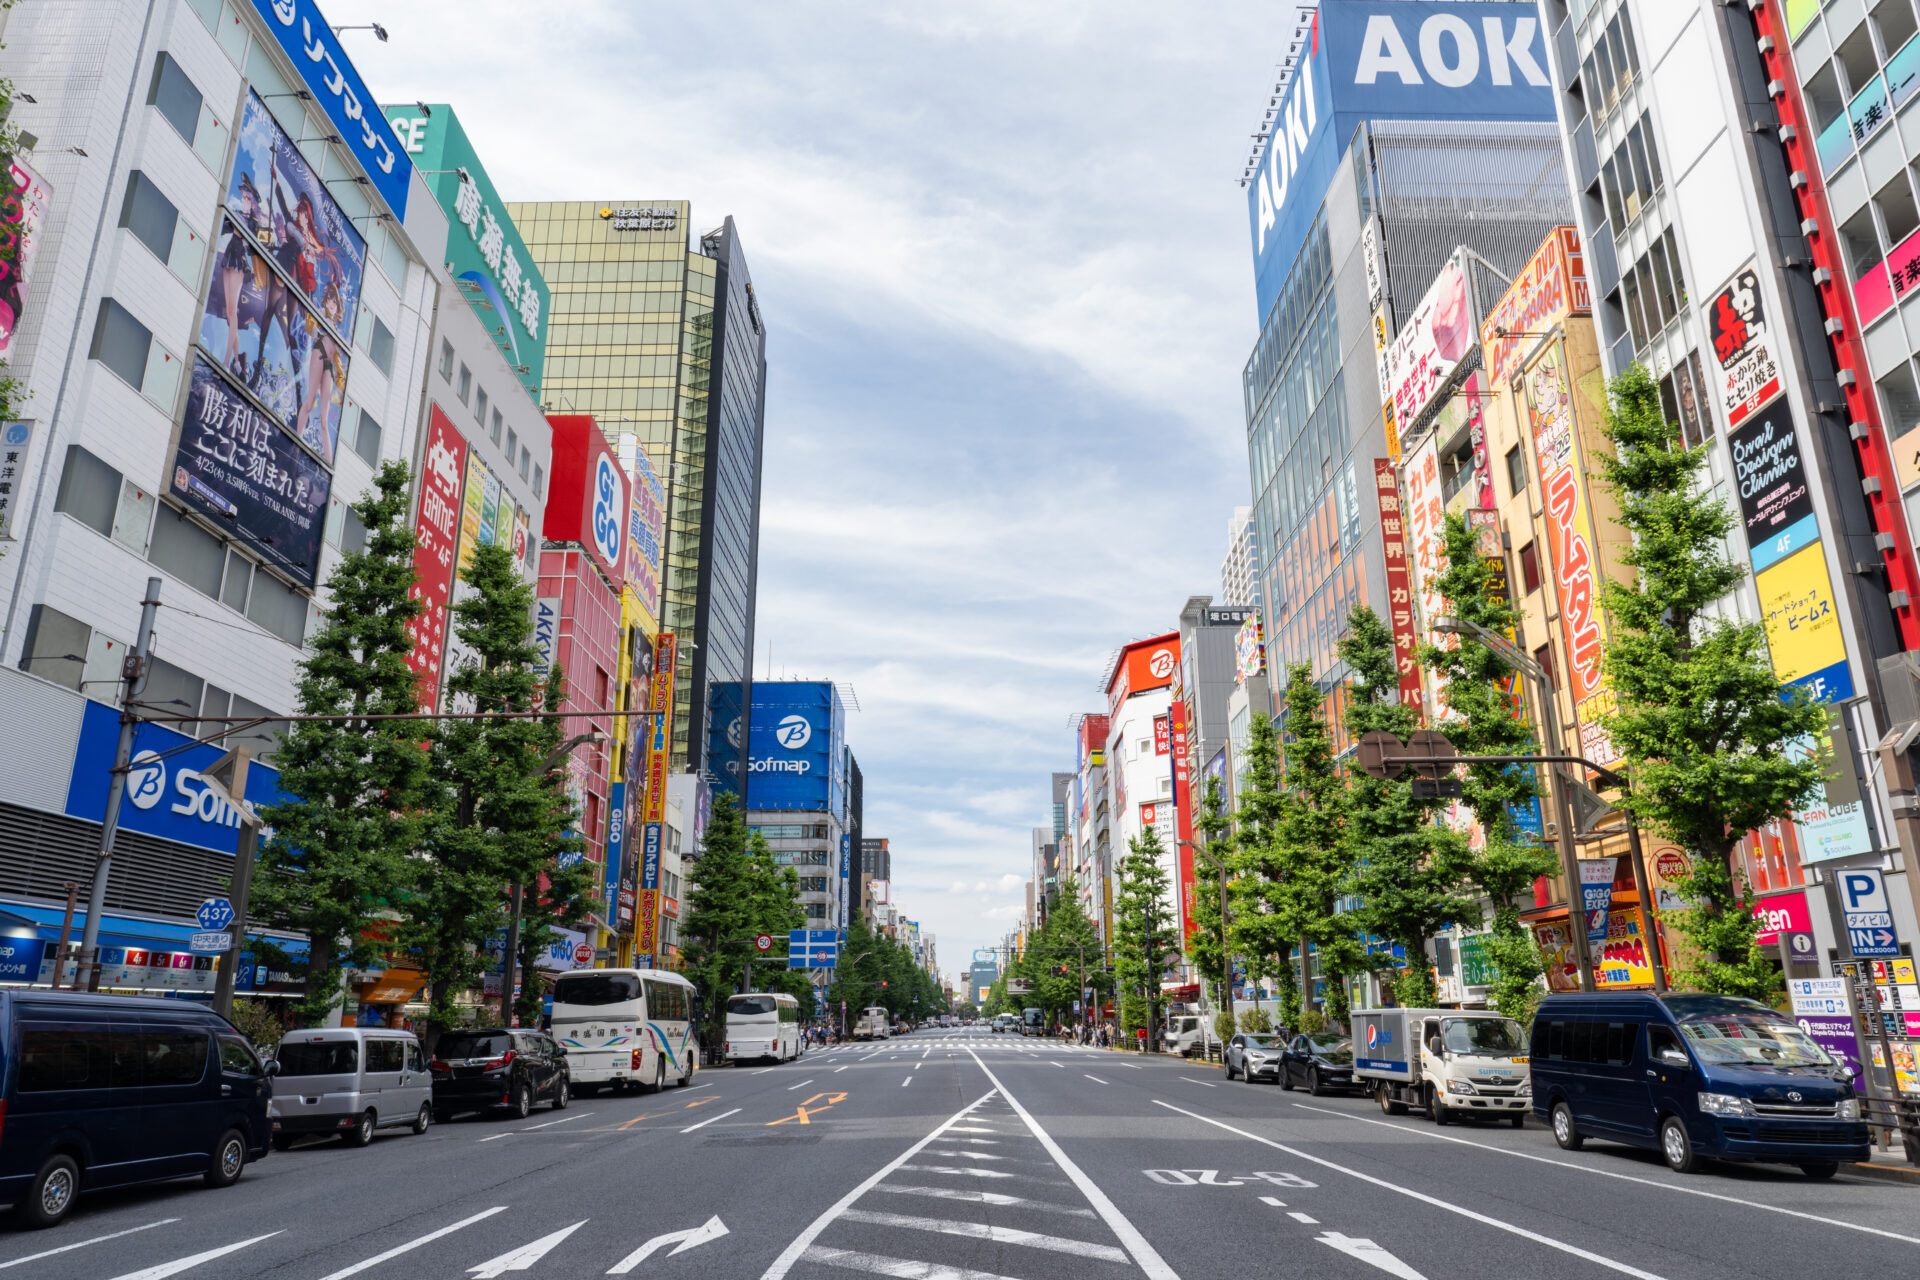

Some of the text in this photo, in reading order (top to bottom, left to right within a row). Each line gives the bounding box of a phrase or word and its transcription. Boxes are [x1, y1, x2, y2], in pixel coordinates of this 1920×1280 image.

[302, 16, 396, 174] ソフマップ
[1258, 52, 1317, 256] AOKI
[613, 218, 676, 231] 秋葉原ビル
[614, 206, 677, 218] 住友不動産
[1398, 304, 1432, 361] ハニトー
[1394, 348, 1436, 410] 曲数世界一
[1725, 360, 1777, 409] セセリ焼き
[1727, 345, 1769, 393] 赤から鍋
[1397, 367, 1439, 434] カラオケ
[1746, 393, 1761, 413] 5F
[199, 384, 276, 461] 勝利は、
[194, 423, 315, 514] ここに刻まれた。
[1736, 431, 1795, 481] Design
[1740, 454, 1798, 499] Clinic
[423, 485, 455, 541] GAME
[418, 525, 452, 569] 2F 4F
[1776, 534, 1792, 554] 4F
[1376, 472, 1421, 706] 曲数世界一カラオケパ
[1548, 465, 1604, 692] ラムタラ
[1769, 589, 1817, 621] カードショップ
[1788, 600, 1831, 631] ビームス
[656, 674, 669, 710] ムーラン
[747, 757, 811, 775] Sofmap
[1176, 733, 1188, 781] 坂口電熱
[610, 808, 622, 844] GiGO
[1803, 803, 1859, 824] FAN CUBE
[1658, 863, 1684, 874] 消火栓
[1584, 888, 1611, 900] GiGO
[1586, 899, 1609, 910] EXPO
[1845, 875, 1876, 908] P
[200, 907, 230, 921] 437
[1849, 914, 1889, 927] ダイビル
[193, 933, 229, 944] 中央通り
[758, 938, 770, 947] 50
[1849, 929, 1875, 947] IN
[132, 952, 143, 964] 4F
[156, 954, 166, 966] 5F
[178, 956, 188, 968] 6F
[200, 958, 208, 969] 7F
[1377, 1027, 1392, 1047] pepsi
[1477, 1068, 1513, 1076] SUNTORY
